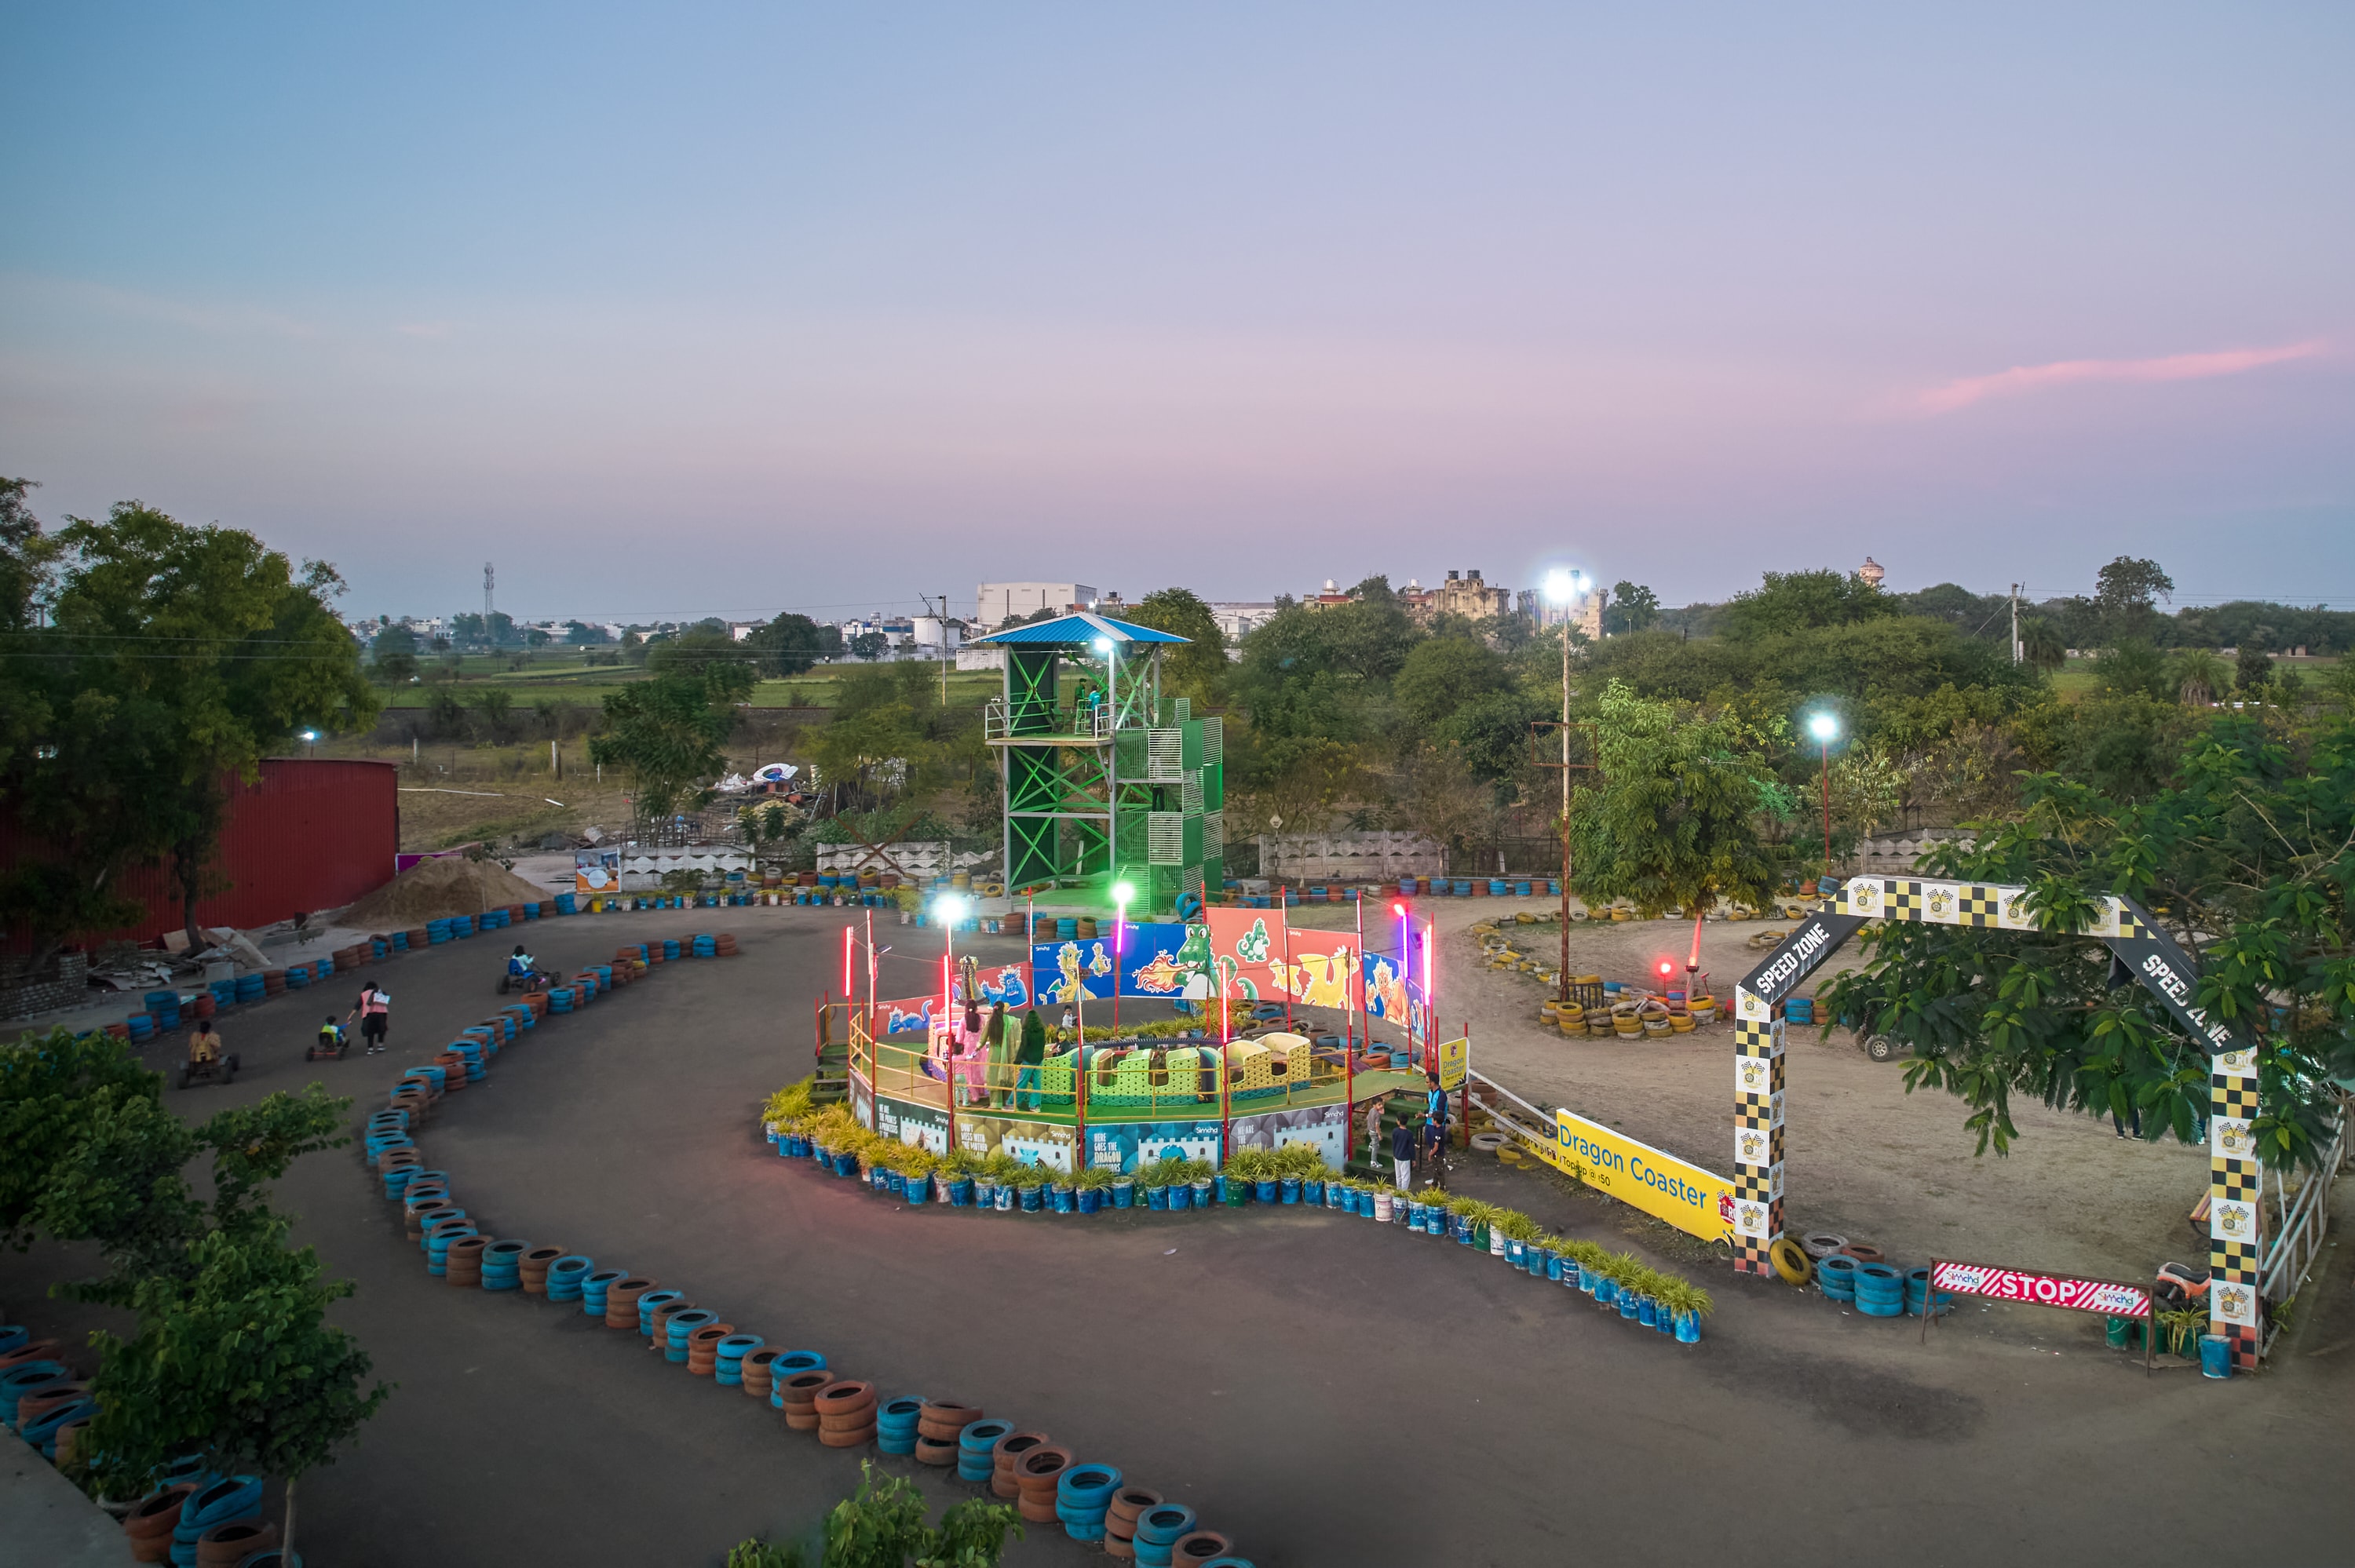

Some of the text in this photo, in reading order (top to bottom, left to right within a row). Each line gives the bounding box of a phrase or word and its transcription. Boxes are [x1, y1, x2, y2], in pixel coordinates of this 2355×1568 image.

[1756, 921, 1831, 994] SPEED ZONE
[1443, 1057, 1464, 1070] Dragon
[1442, 1065, 1464, 1078] Coaster
[1245, 1124, 1254, 1134] ARE
[1094, 1132, 1106, 1143] HERE
[1237, 1135, 1246, 1144] THE
[1094, 1141, 1117, 1152] GOES THE
[1094, 1151, 1122, 1164] DRAGON
[1559, 1124, 1707, 1209] Dragon Coaster
[2001, 1274, 2077, 1302] STOP
